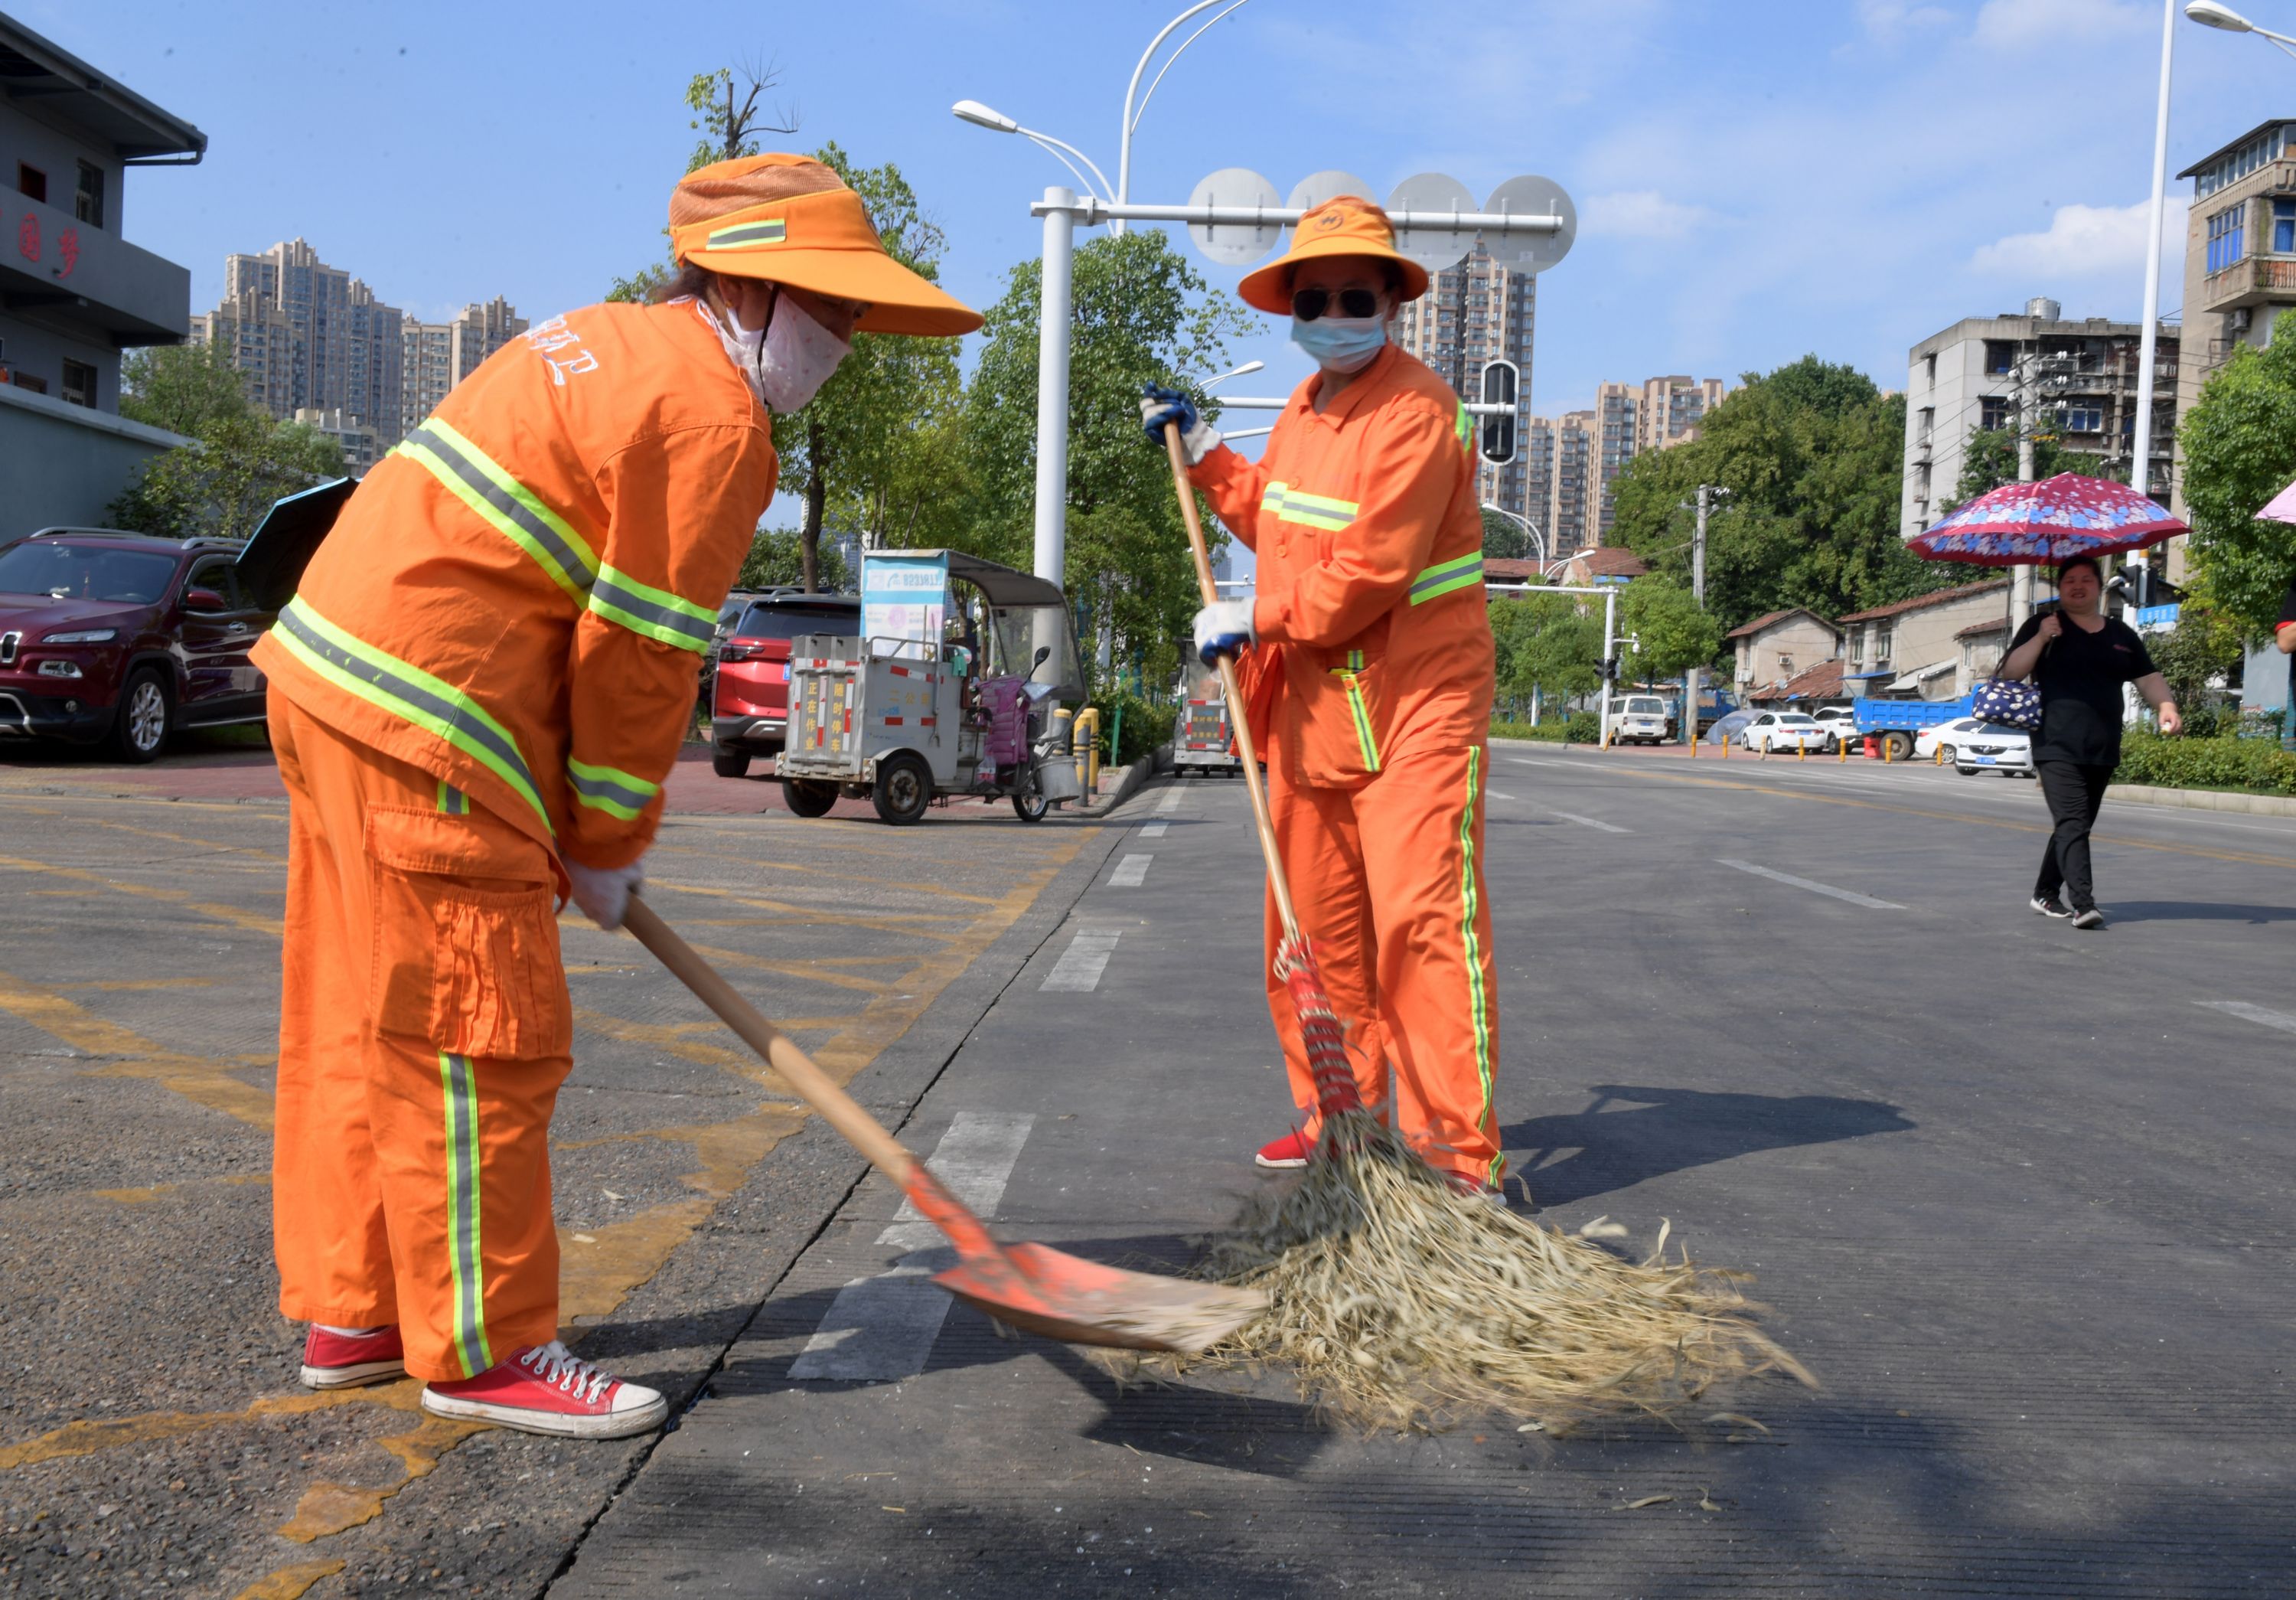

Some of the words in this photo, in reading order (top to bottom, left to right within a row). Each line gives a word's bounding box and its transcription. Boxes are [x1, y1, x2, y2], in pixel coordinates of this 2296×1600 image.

[805, 681, 818, 751] 正在作业
[831, 682, 845, 753] 随时停车
